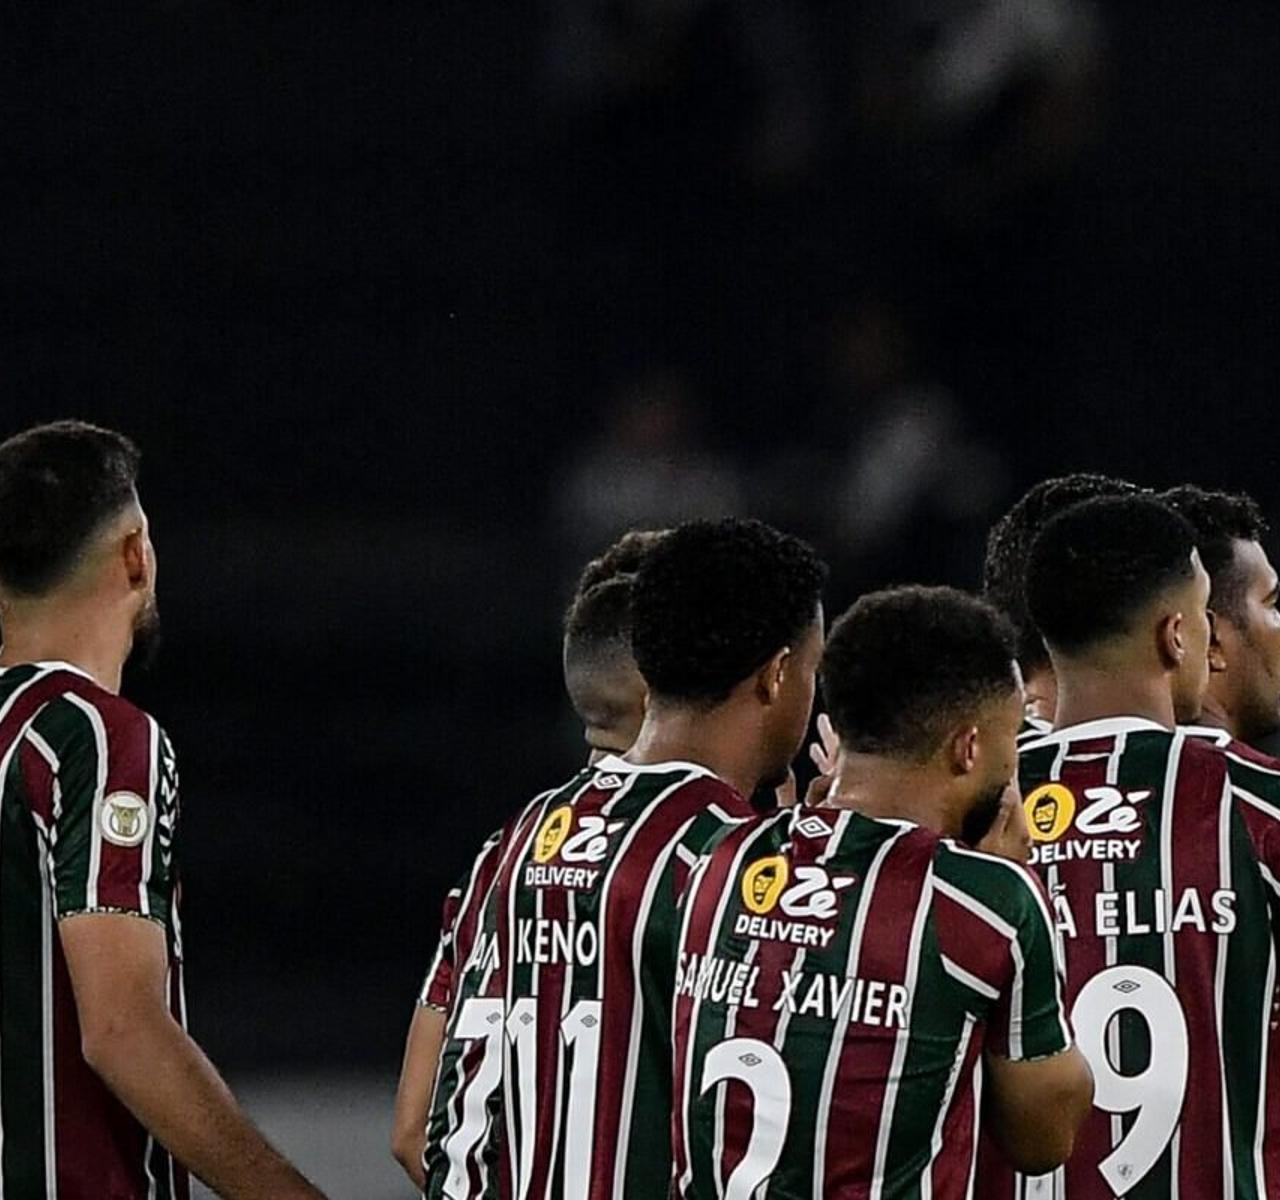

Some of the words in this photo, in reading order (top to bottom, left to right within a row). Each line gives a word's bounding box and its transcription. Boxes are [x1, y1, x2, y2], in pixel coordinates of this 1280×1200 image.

[1074, 786, 1152, 835] Zé
[560, 815, 626, 863] Zé
[1026, 839, 1141, 866] DELIVERY
[524, 865, 599, 889] DELIVERY
[779, 866, 856, 919] Zé
[734, 914, 835, 947] DELIVERY
[1095, 887, 1237, 937] ELIAS
[516, 918, 597, 966] KENO
[676, 951, 760, 1009] SAMUEL
[772, 970, 910, 1030] XAVIER
